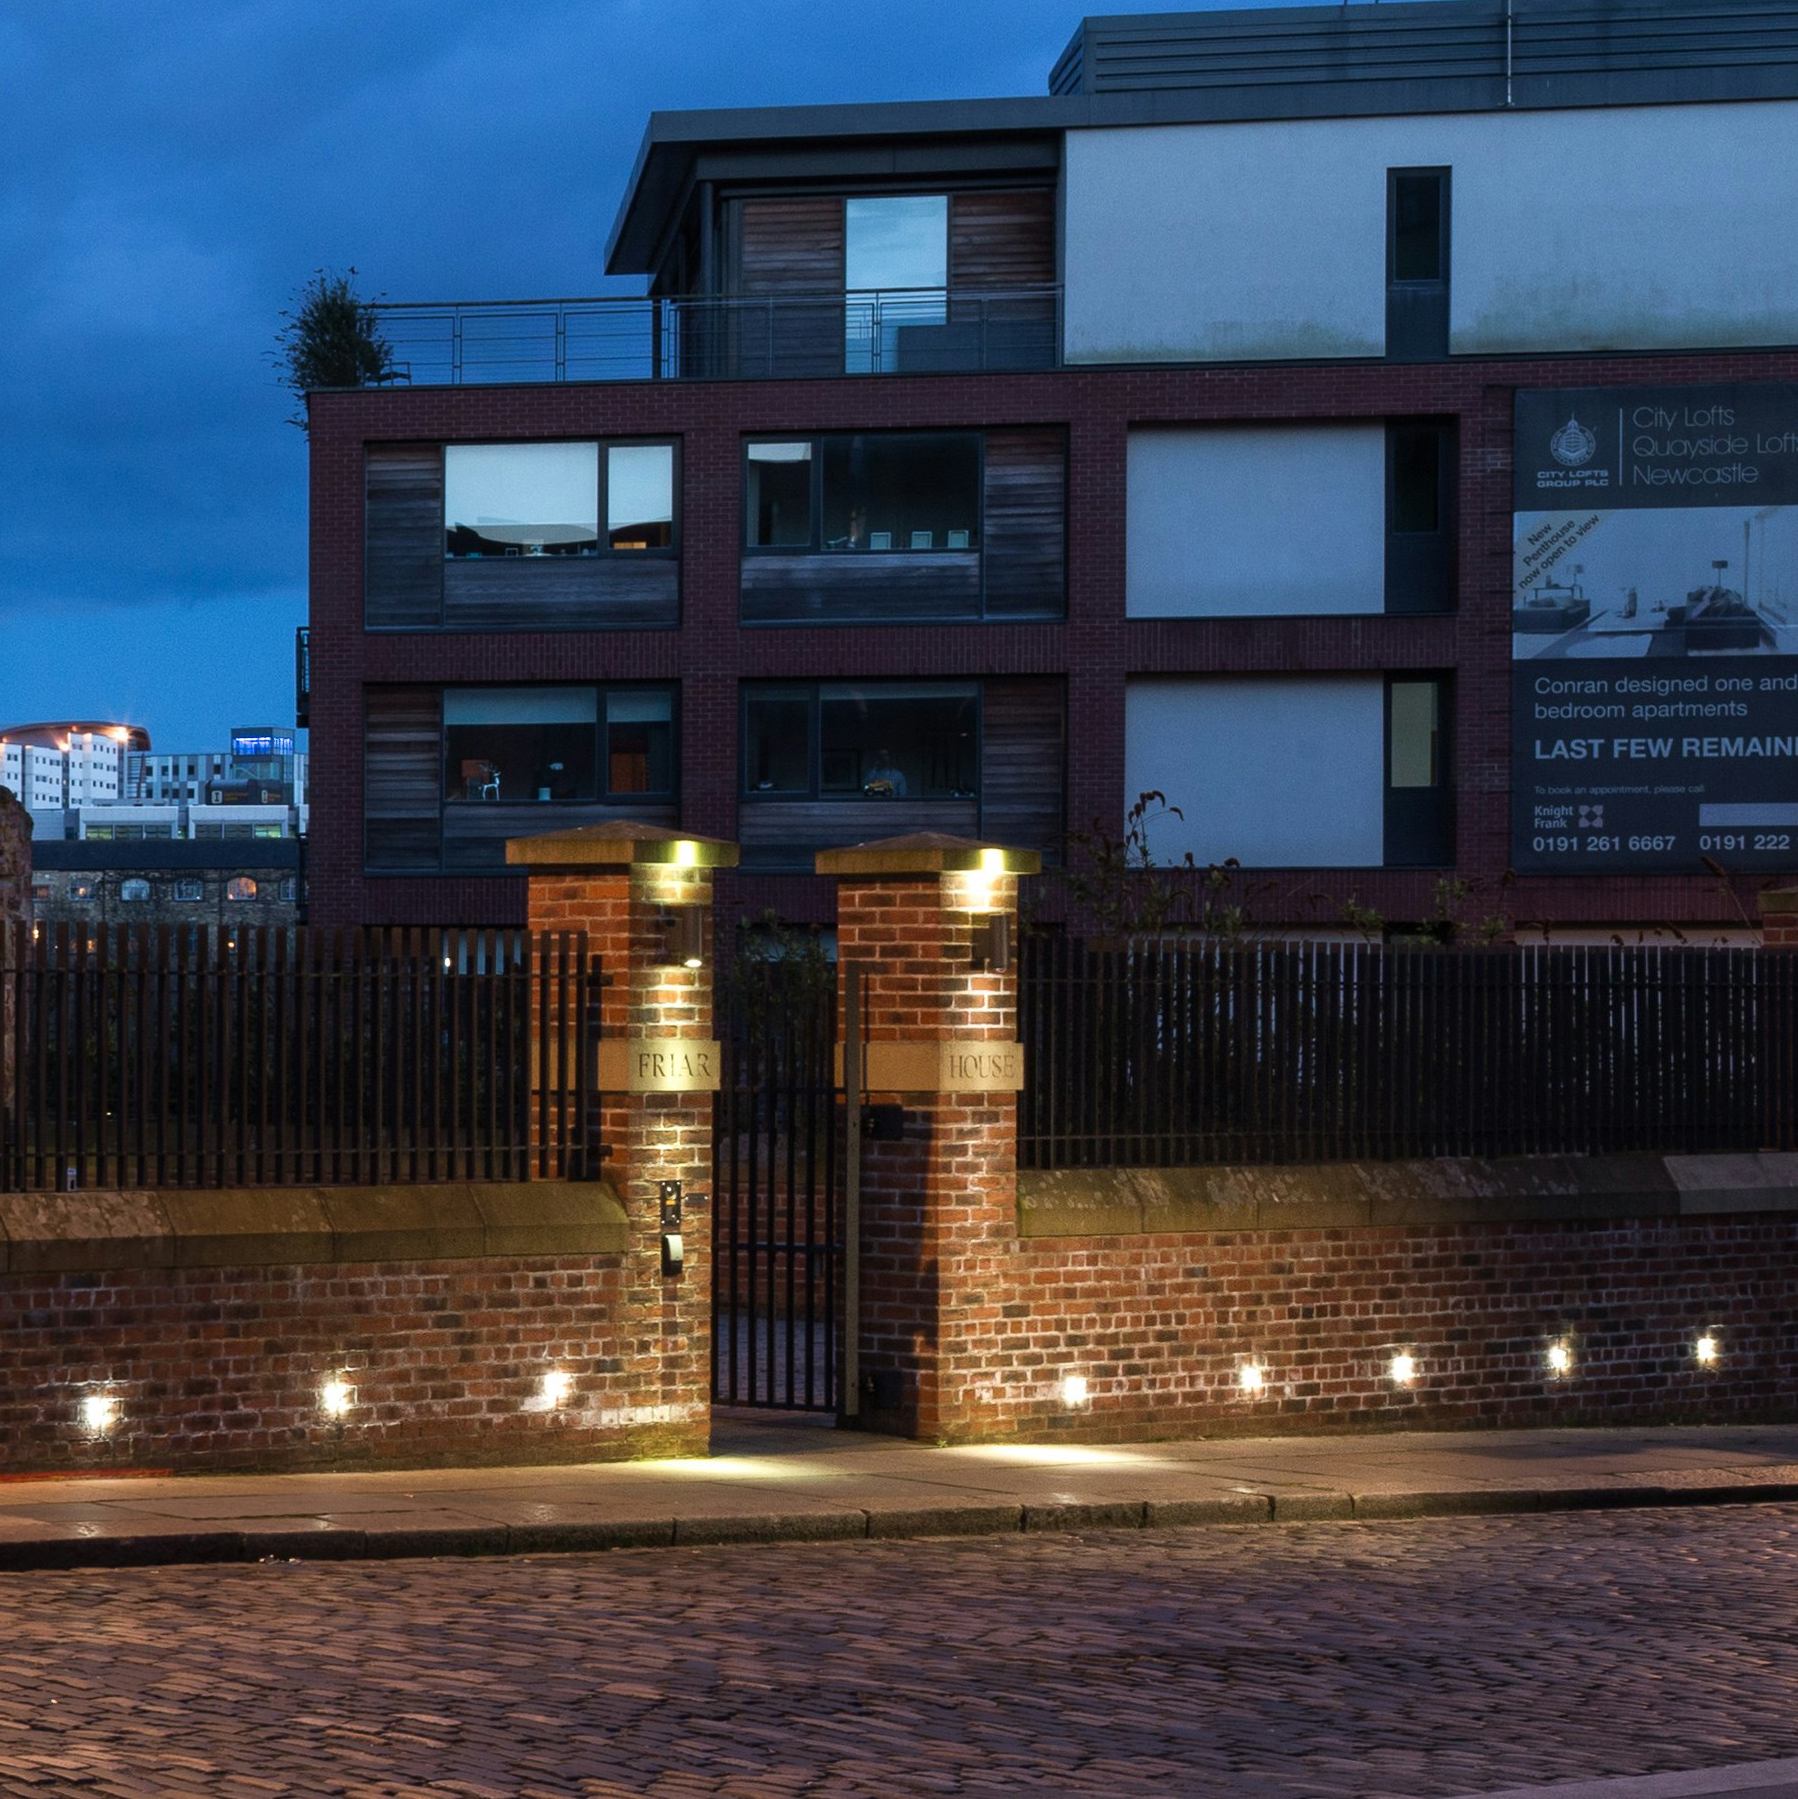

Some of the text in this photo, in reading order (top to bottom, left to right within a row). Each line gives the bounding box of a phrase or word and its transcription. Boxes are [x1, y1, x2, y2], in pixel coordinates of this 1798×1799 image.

[1633, 405, 1735, 431] City Lofts
[1633, 431, 1798, 459] Quayside Loft
[1537, 469, 1609, 479] CITY LOFTS
[1537, 479, 1609, 488] GROUP PLC
[1633, 462, 1759, 485] Newcastle
[1523, 520, 1576, 566] Penthouse
[1527, 523, 1553, 545] New
[1518, 514, 1600, 589] now open to view
[1534, 674, 1798, 696] Conran designed one and
[1534, 700, 1748, 722] bedroom apartments
[1535, 739, 1605, 761] LAST
[1613, 738, 1674, 760] FEW
[1534, 785, 1545, 794] To
[1548, 785, 1572, 795] book
[1575, 787, 1587, 795] an
[1654, 785, 1686, 796] please
[1688, 784, 1705, 794] call
[1534, 805, 1574, 817] Knight
[1534, 817, 1567, 829] Frank
[1533, 835, 1676, 852] 0191 261 6667
[1700, 834, 1745, 851] 0191
[1753, 834, 1790, 850] 222
[638, 1053, 712, 1078] FRIAR
[949, 1054, 1015, 1079] HOUSE
